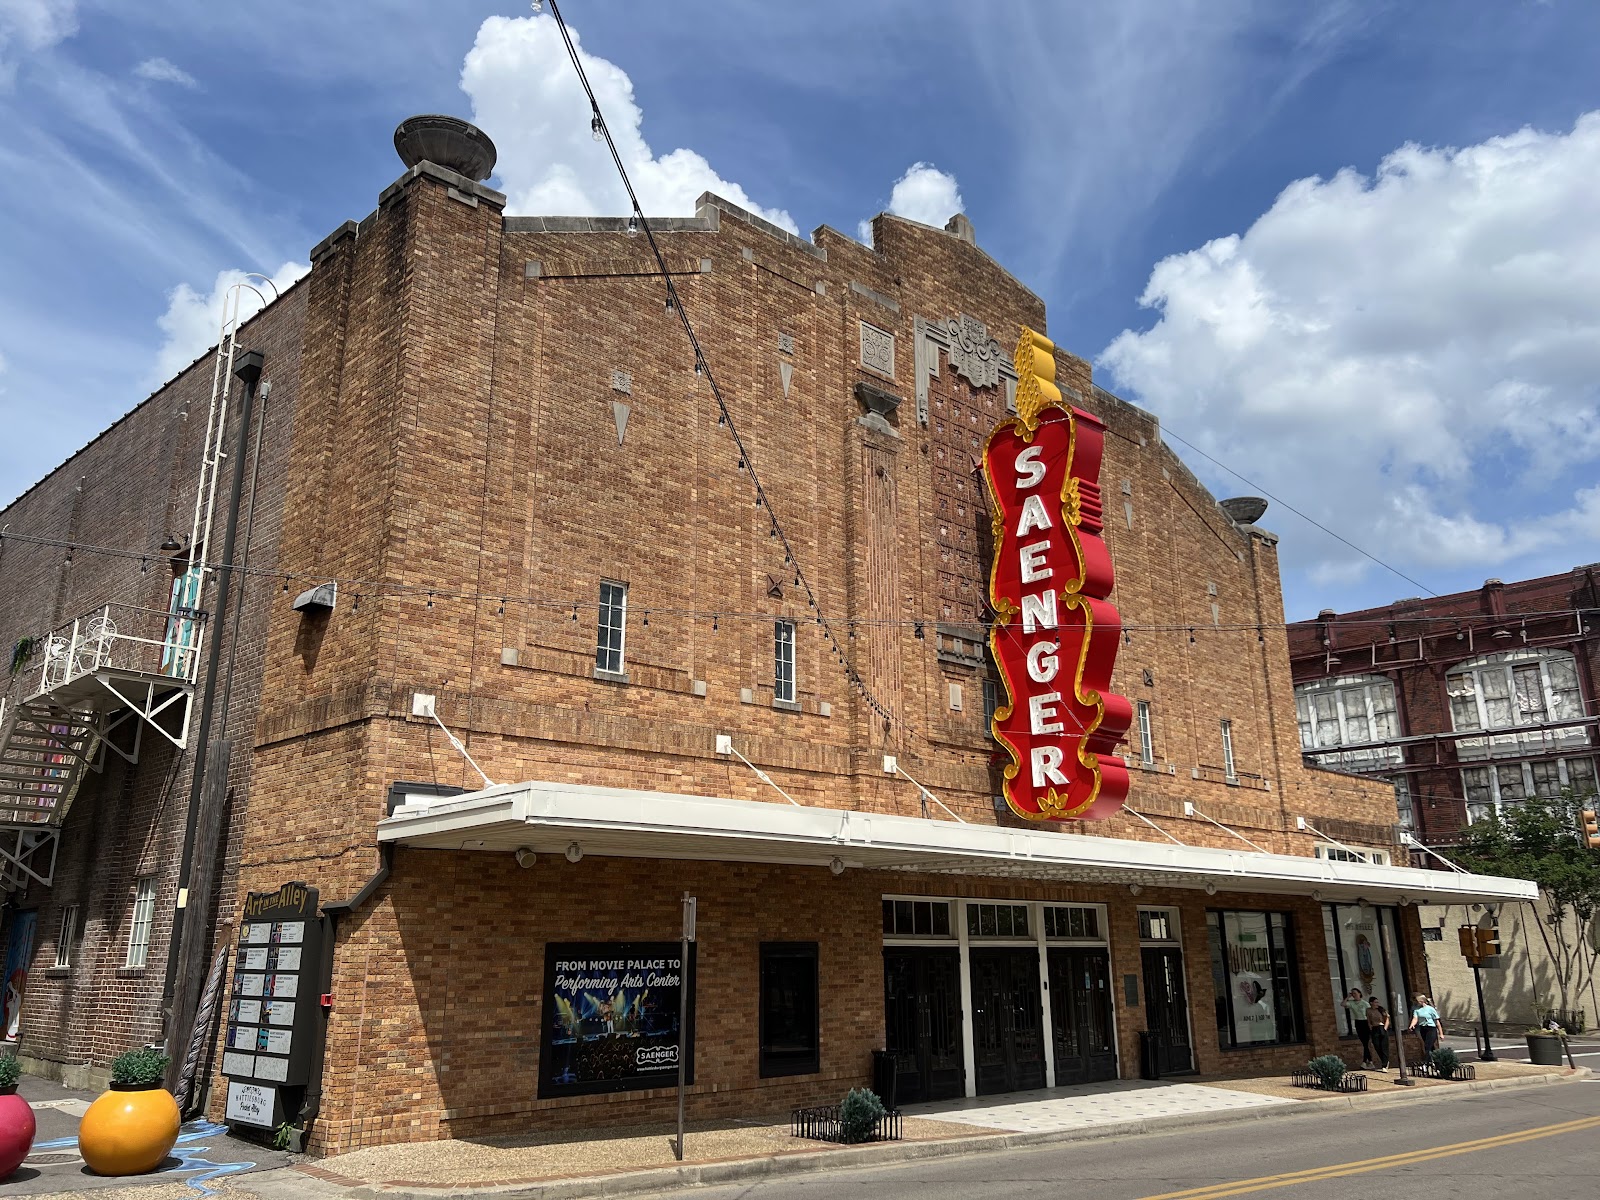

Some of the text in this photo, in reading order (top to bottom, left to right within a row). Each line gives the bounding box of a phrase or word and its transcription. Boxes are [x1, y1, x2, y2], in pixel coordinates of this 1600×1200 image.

[1015, 445, 1070, 788] SAENGER
[245, 895, 263, 915] Art
[278, 884, 307, 913] Alley
[555, 959, 681, 971] FROM MOVIE PALACE TO
[1228, 941, 1270, 976] WICKED
[555, 972, 680, 996] Performing Arts Center
[641, 1051, 674, 1060] SAENGER
